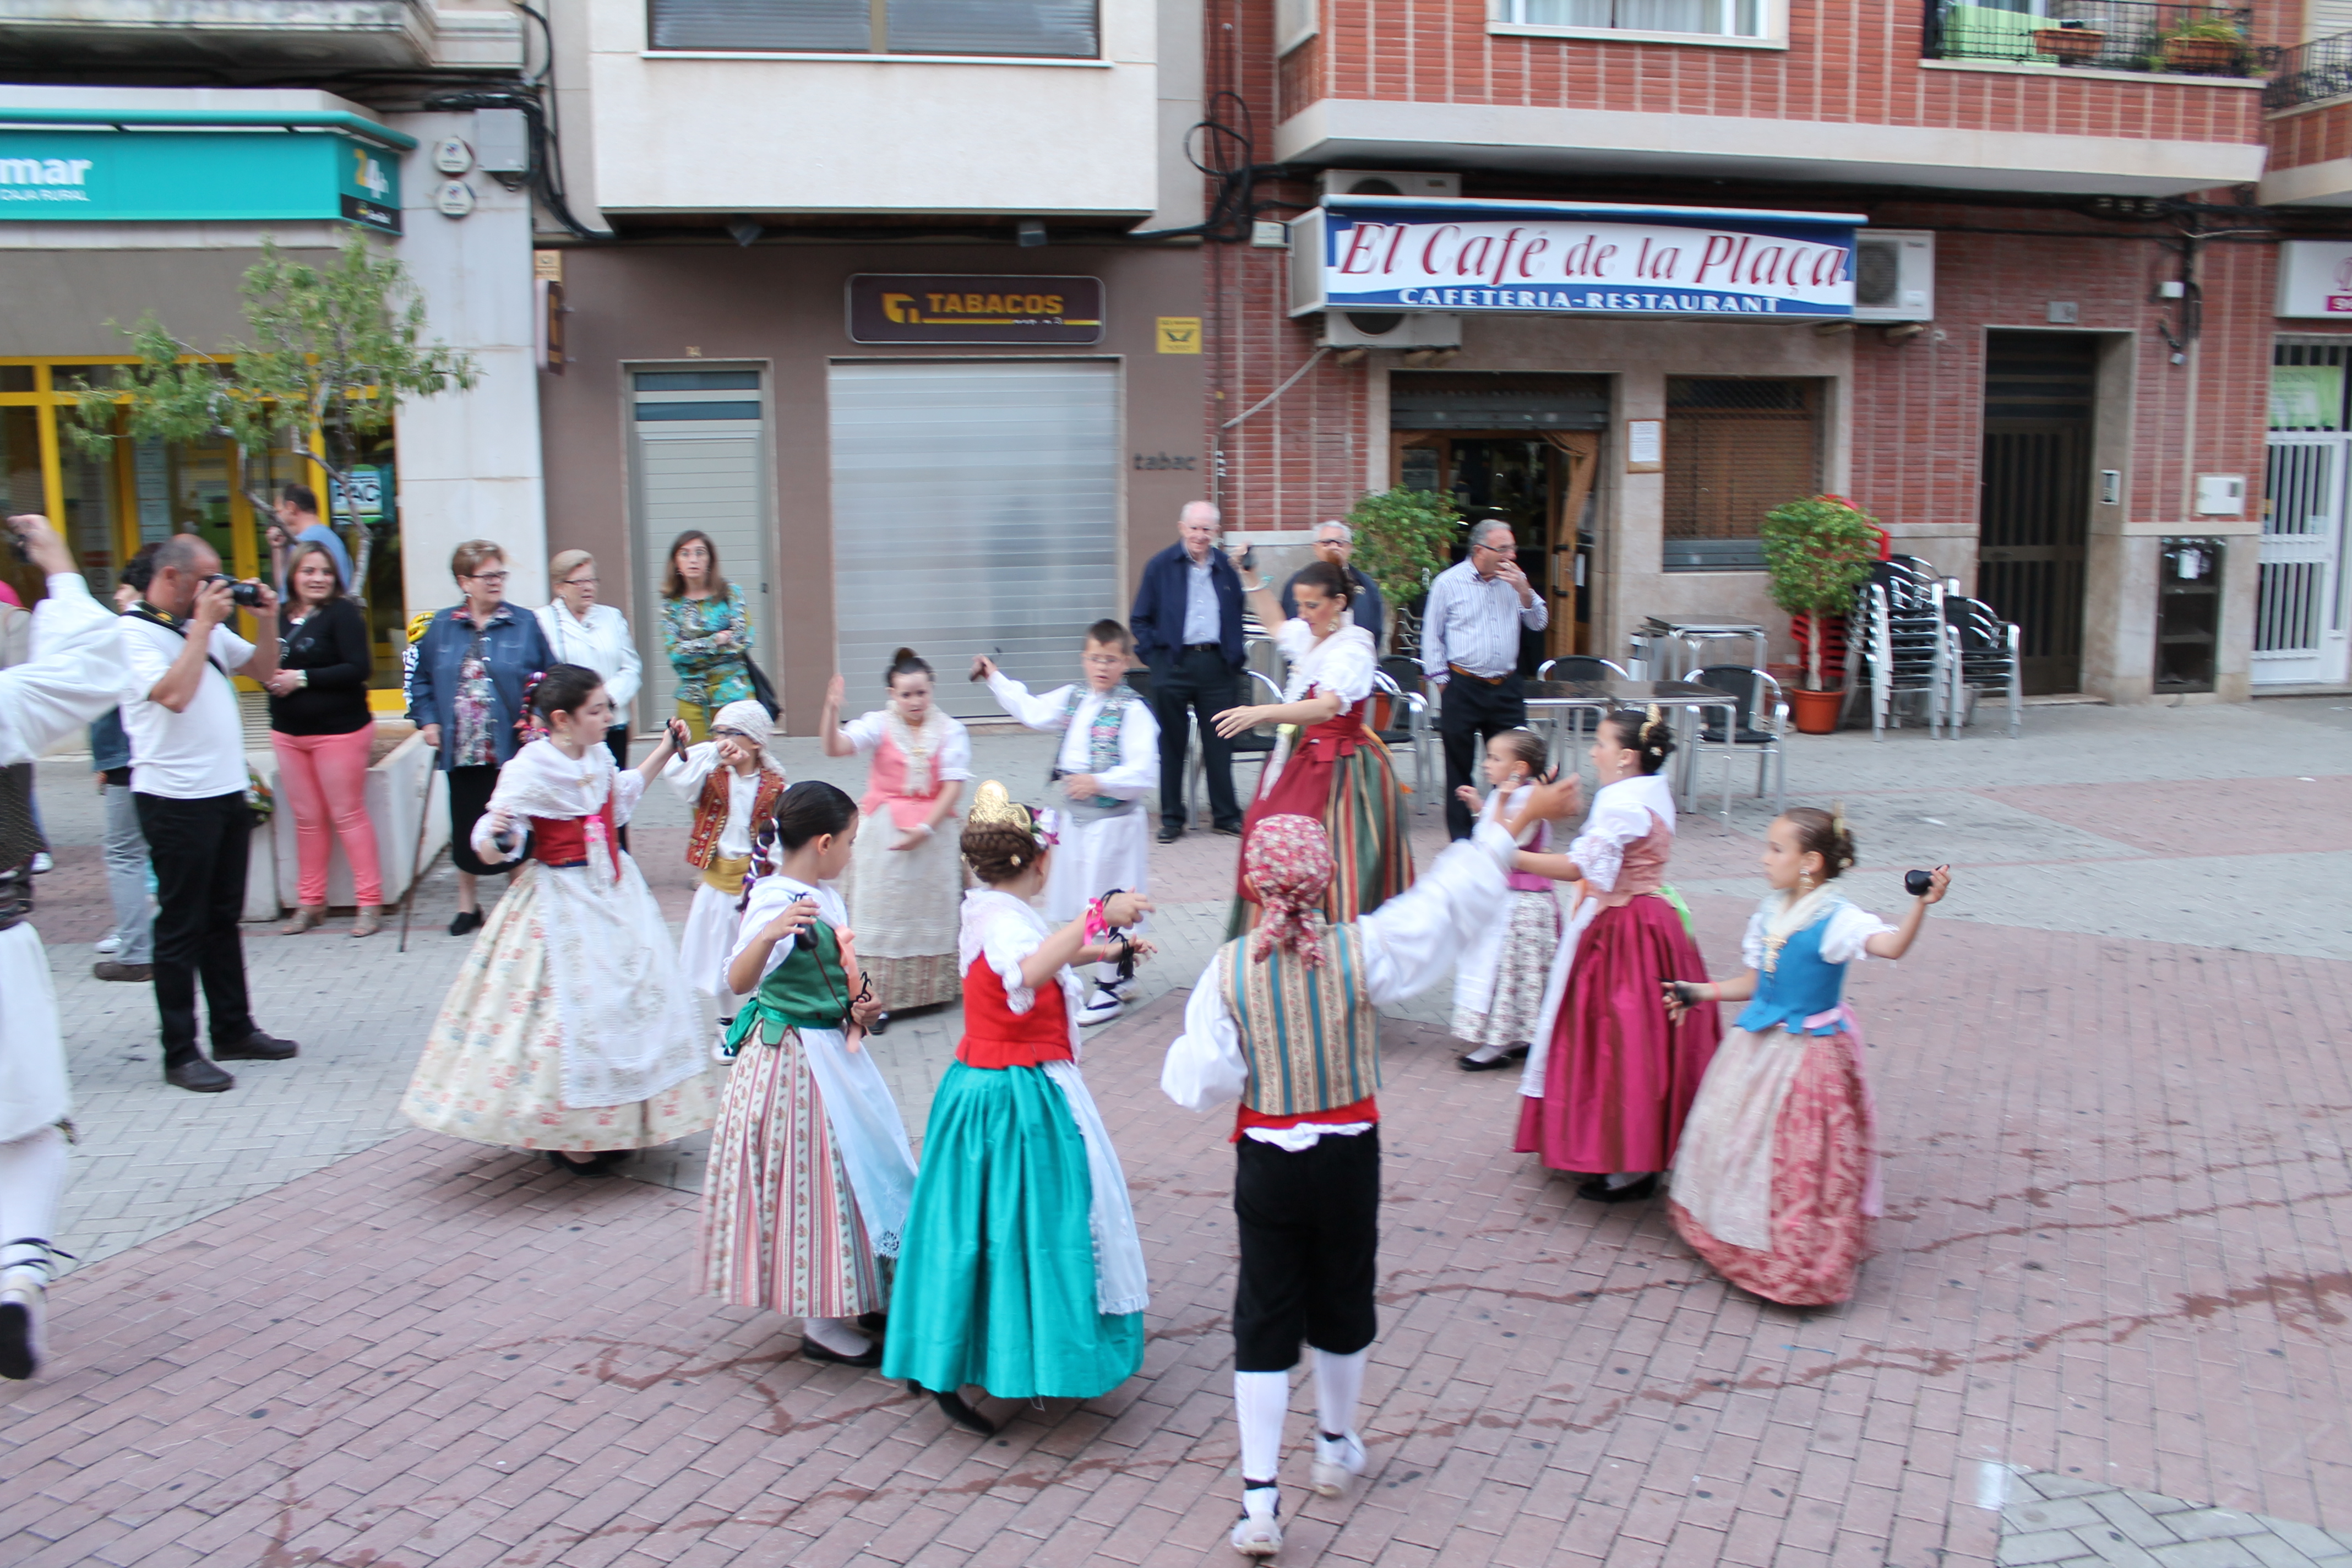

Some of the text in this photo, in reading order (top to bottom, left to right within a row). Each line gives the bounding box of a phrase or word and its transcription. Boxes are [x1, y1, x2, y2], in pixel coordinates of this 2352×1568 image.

[0, 157, 93, 185] mar
[39, 189, 91, 202] RURAL
[1339, 222, 1847, 296] El Café de la Plaça
[926, 293, 1064, 314] TABACOS
[1398, 288, 1780, 312] CAFETERIA-RESTAURANT
[1134, 451, 1197, 470] tabac
